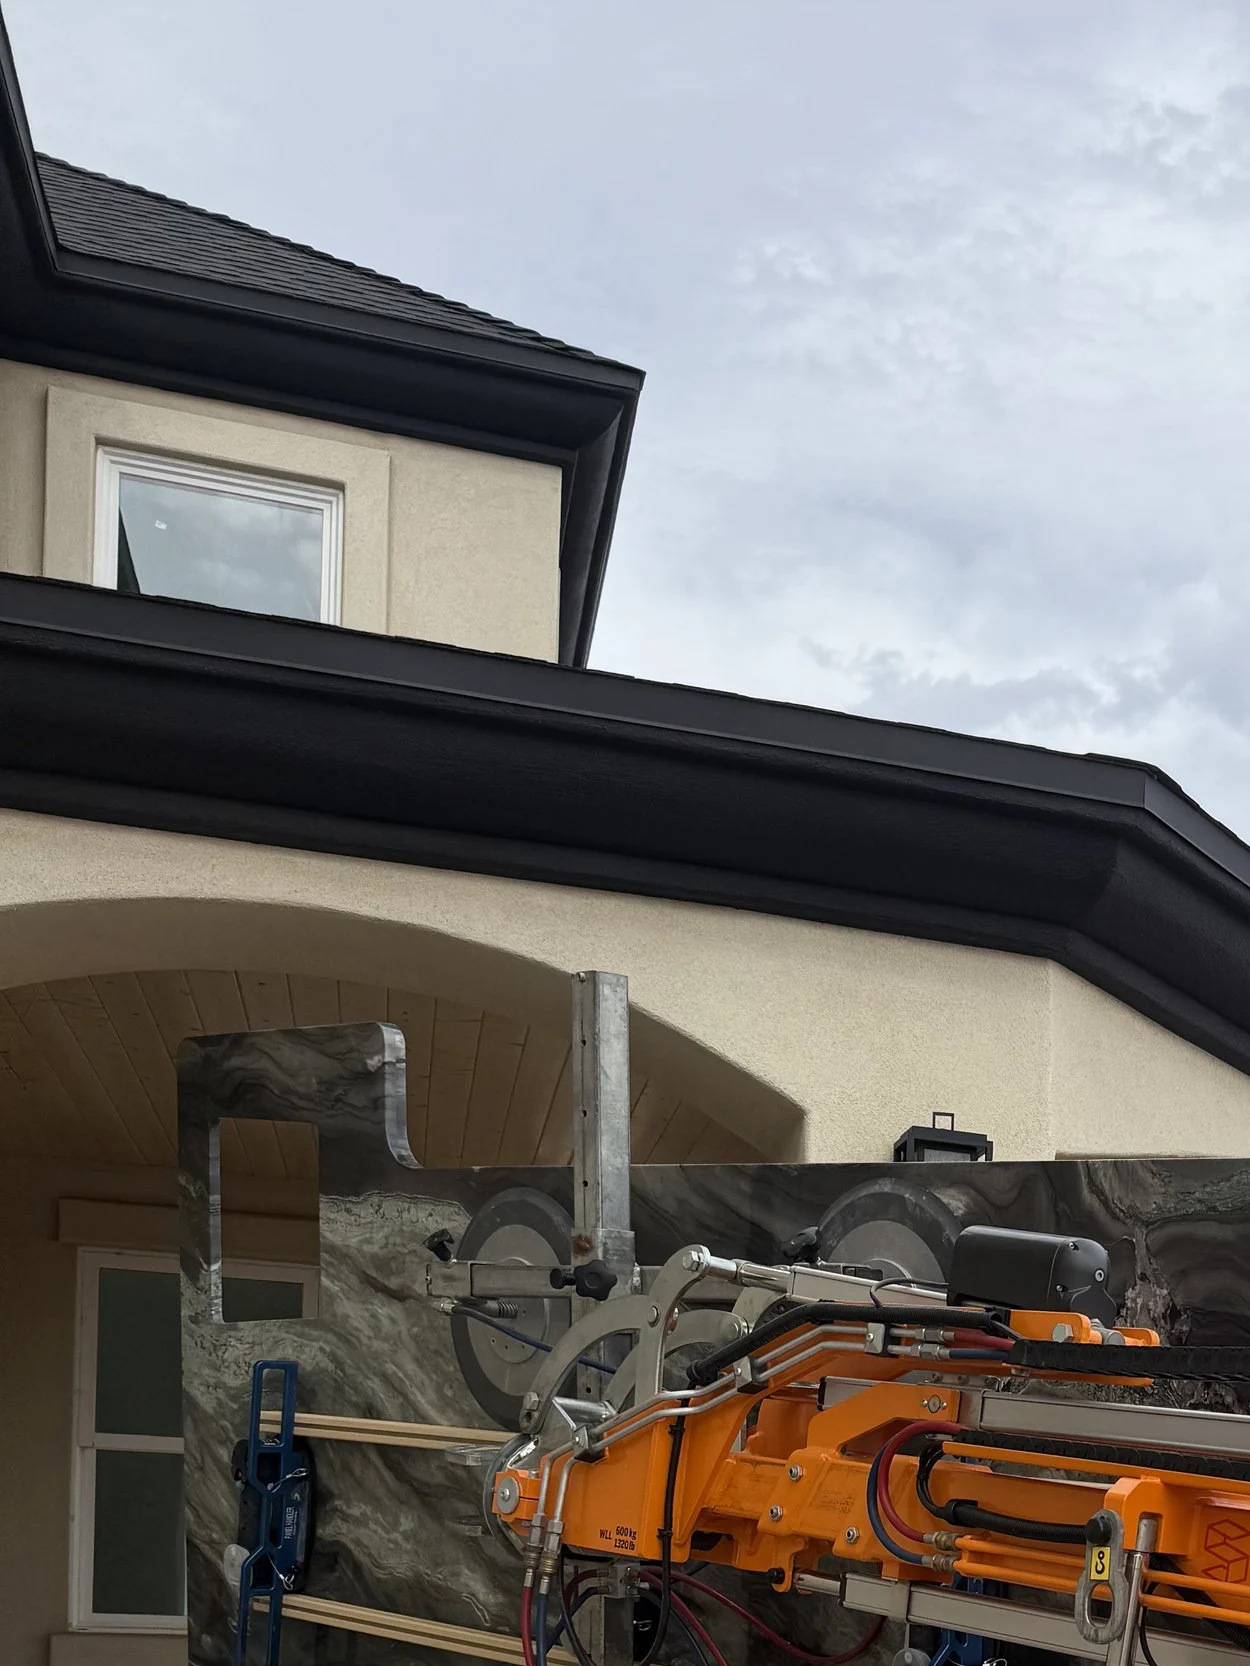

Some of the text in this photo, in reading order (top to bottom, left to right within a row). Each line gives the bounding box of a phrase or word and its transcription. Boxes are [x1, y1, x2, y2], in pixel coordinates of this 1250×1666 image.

[600, 1526, 637, 1541] WLL 600 kg
[614, 1539, 629, 1550] 1320
